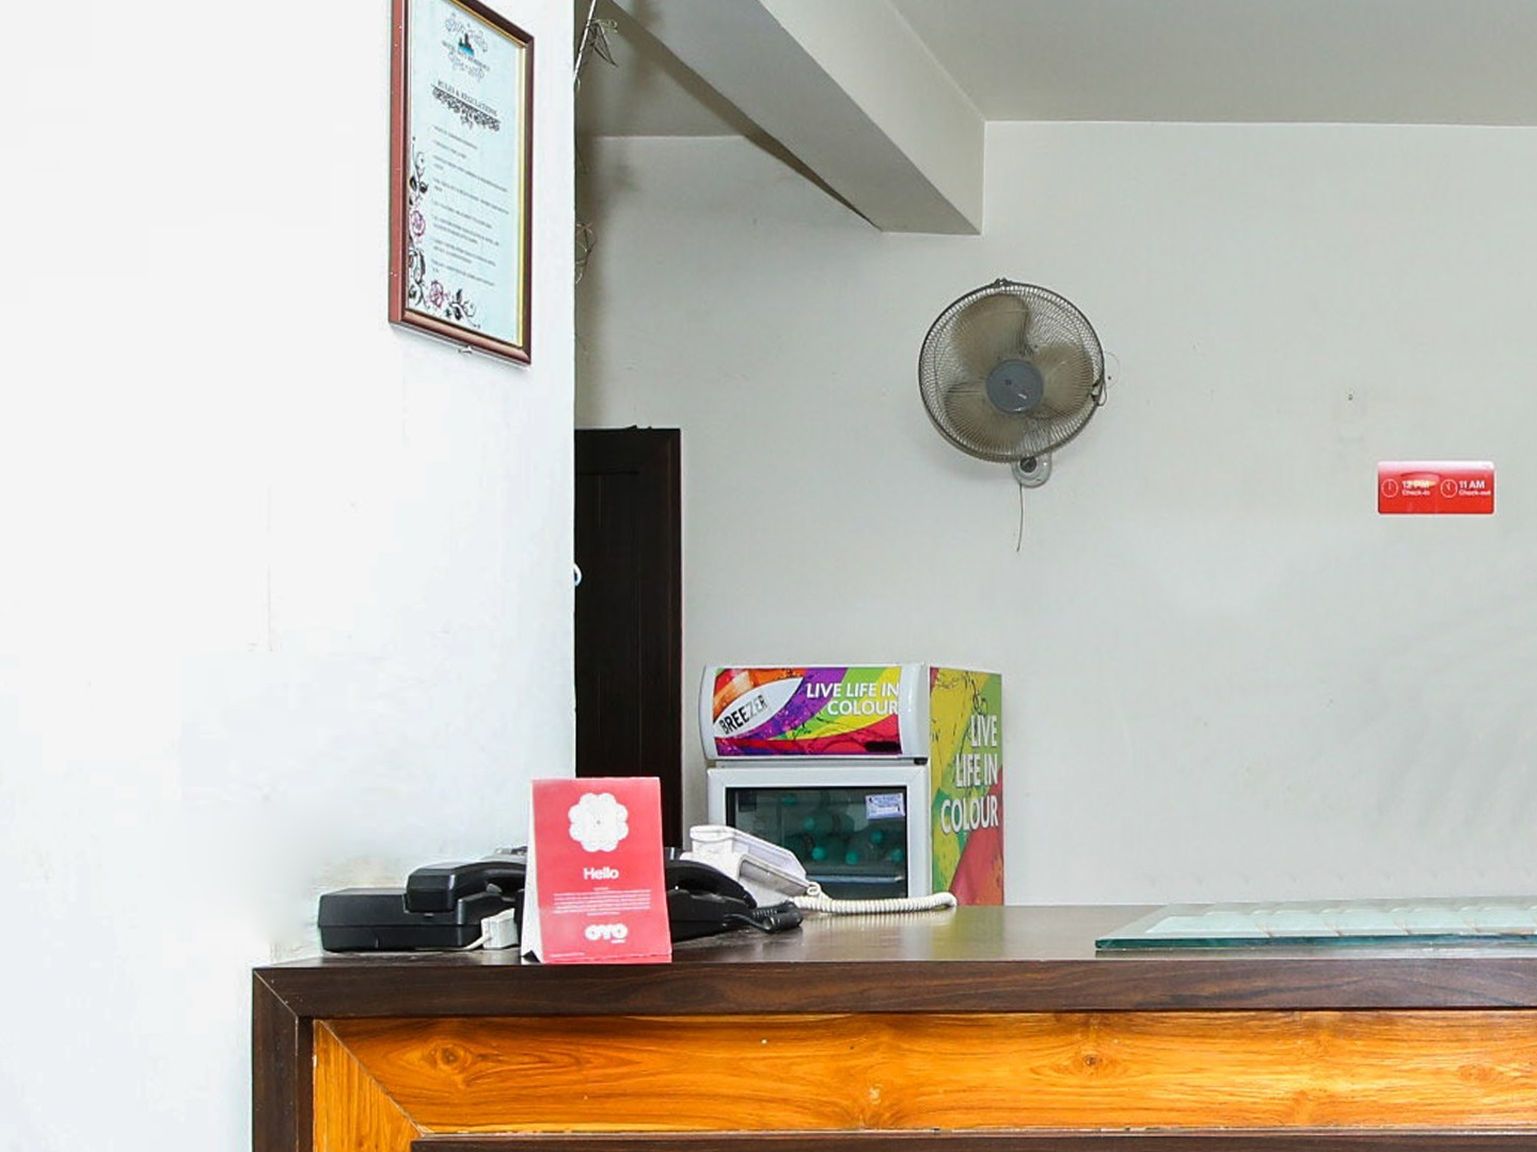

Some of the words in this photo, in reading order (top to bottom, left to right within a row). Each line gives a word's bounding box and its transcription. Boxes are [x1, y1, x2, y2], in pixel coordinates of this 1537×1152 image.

[1459, 480, 1468, 489] 11
[1469, 480, 1485, 489] AM
[806, 682, 842, 698] LIVE
[846, 683, 876, 697] LIFE
[881, 682, 900, 697] IN
[719, 694, 770, 735] BREEZER
[827, 700, 899, 716] COLOUR
[971, 715, 997, 747] LIVE
[956, 753, 980, 787] LIFE
[984, 753, 998, 785] IN
[941, 795, 998, 833] COLOUR
[583, 866, 620, 880] Hello
[584, 923, 628, 941] OYO
